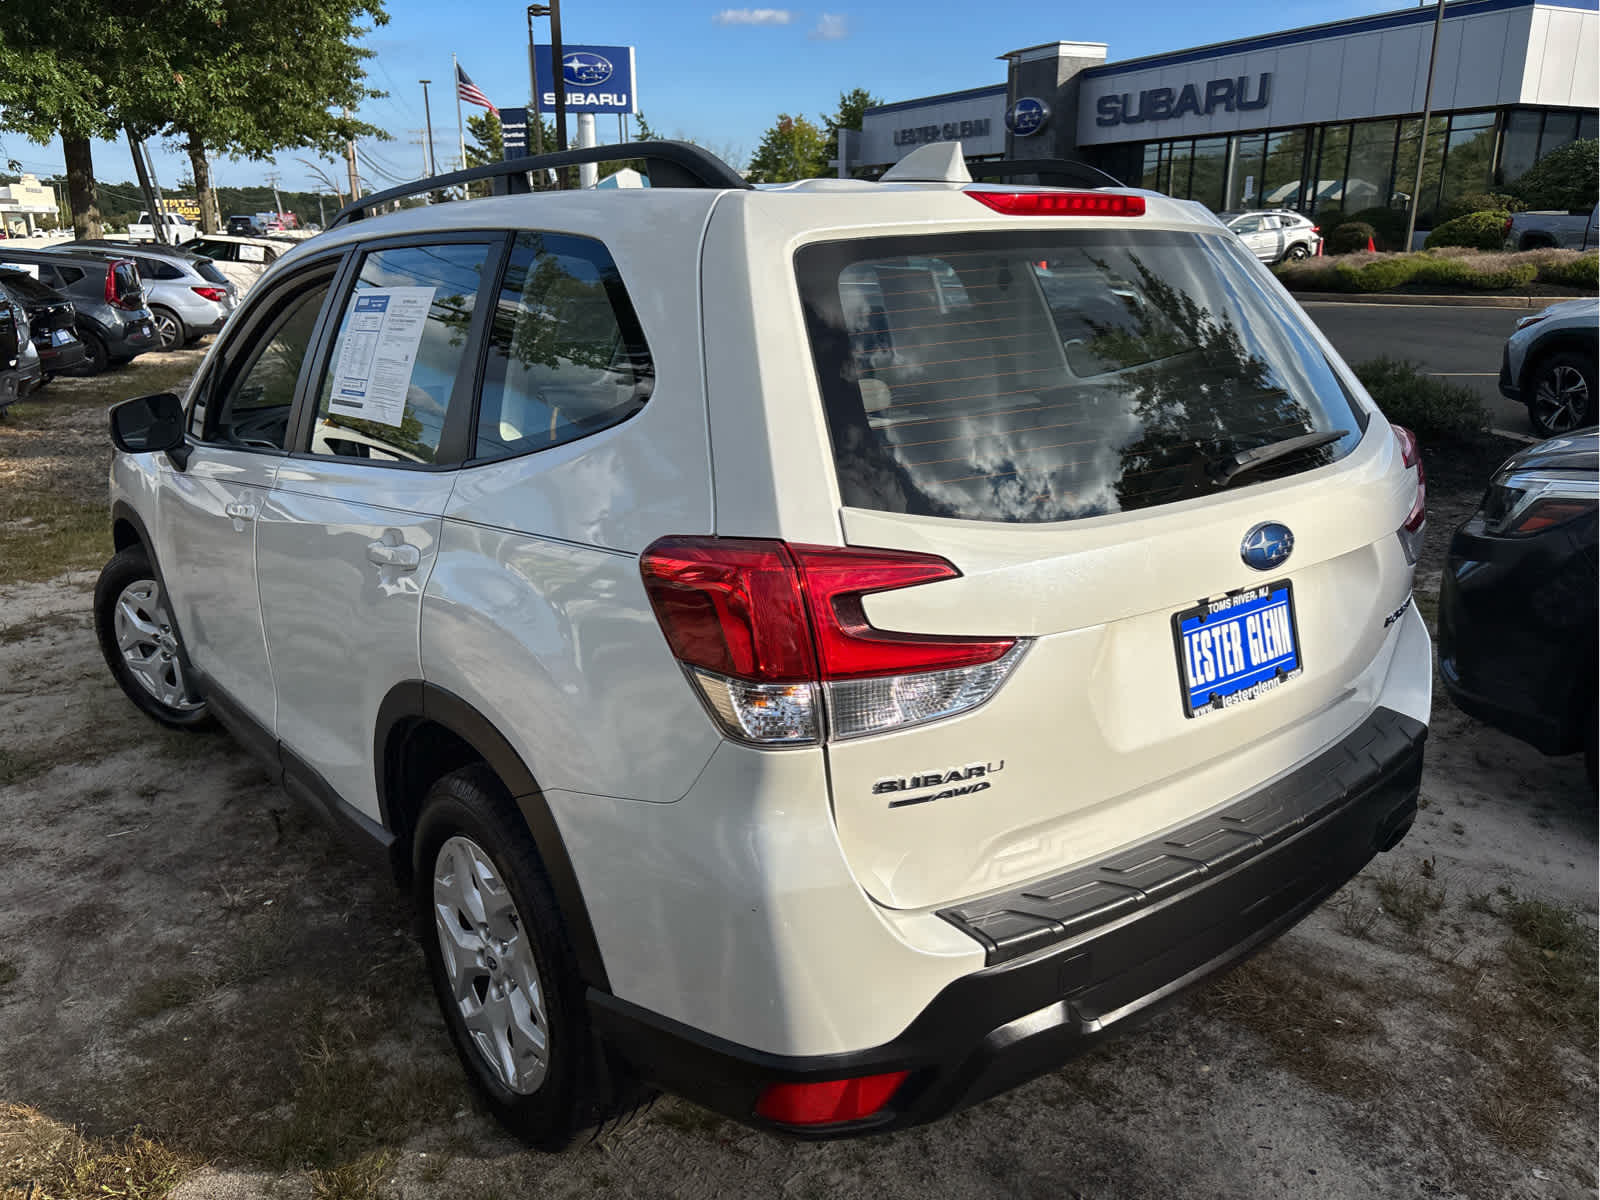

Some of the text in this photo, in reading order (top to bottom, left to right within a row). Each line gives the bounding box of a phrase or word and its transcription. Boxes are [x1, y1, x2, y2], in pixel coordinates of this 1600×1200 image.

[1096, 72, 1272, 127] SUBARU
[1208, 598, 1232, 614] TOMS
[1259, 586, 1269, 598] NJ
[1184, 605, 1292, 688] LESTER GLENN
[872, 759, 1004, 794] SUBARU
[930, 781, 991, 800] AWD
